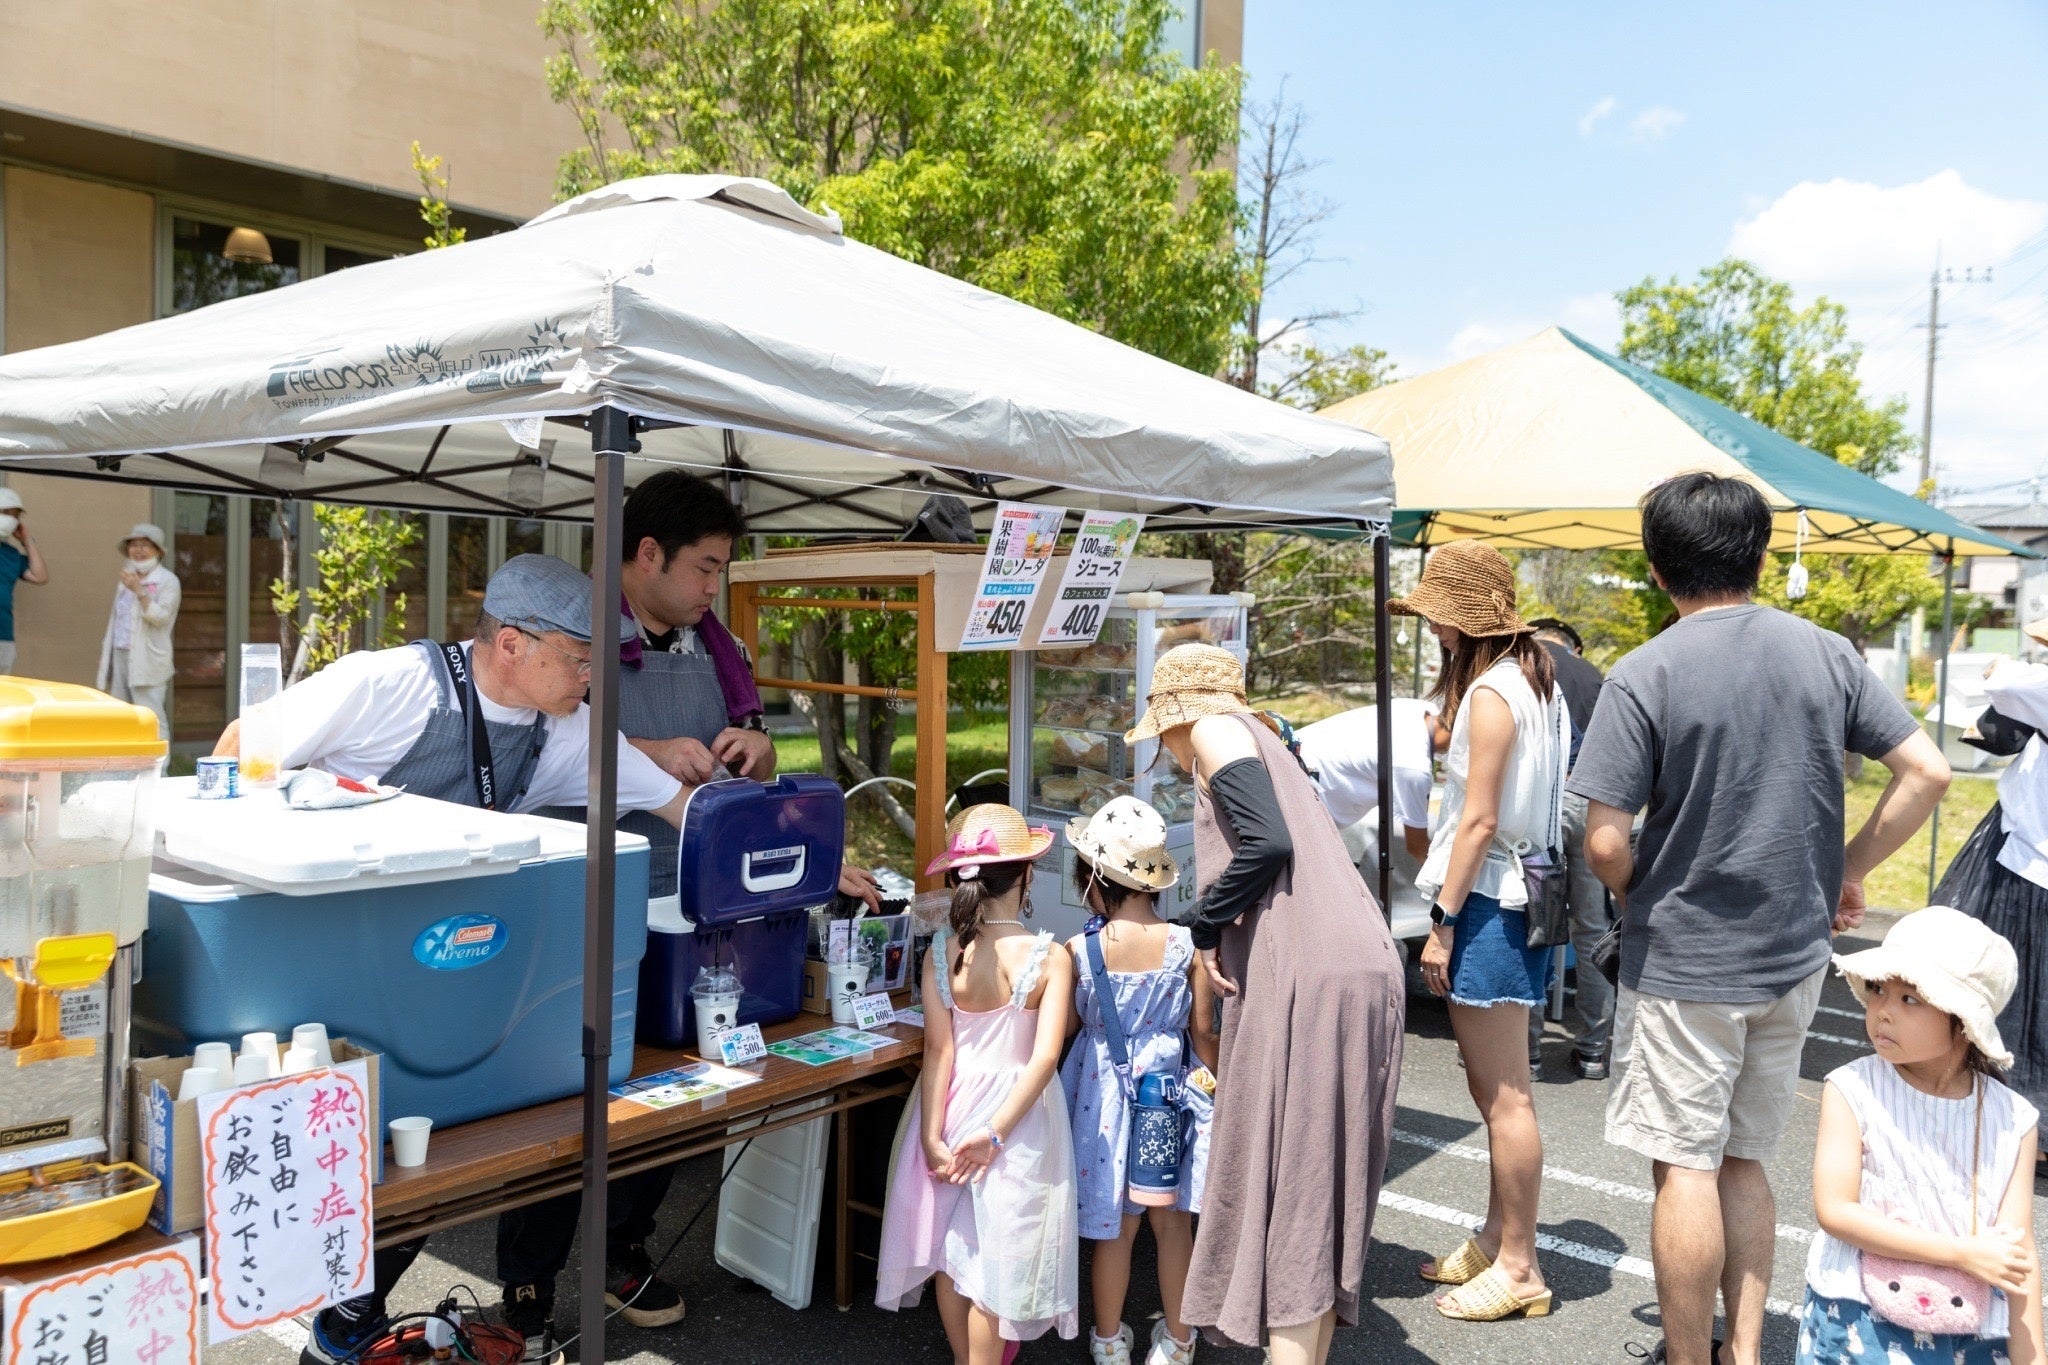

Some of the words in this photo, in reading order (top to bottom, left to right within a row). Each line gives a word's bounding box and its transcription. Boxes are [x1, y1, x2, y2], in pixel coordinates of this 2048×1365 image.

[1075, 558, 1122, 578] ジュース
[446, 645, 468, 684] SONY
[480, 765, 492, 805] SONY
[458, 928, 487, 940] Coleman
[269, 1097, 300, 1229] ご自由に
[304, 1086, 357, 1300] 熱中症対策に
